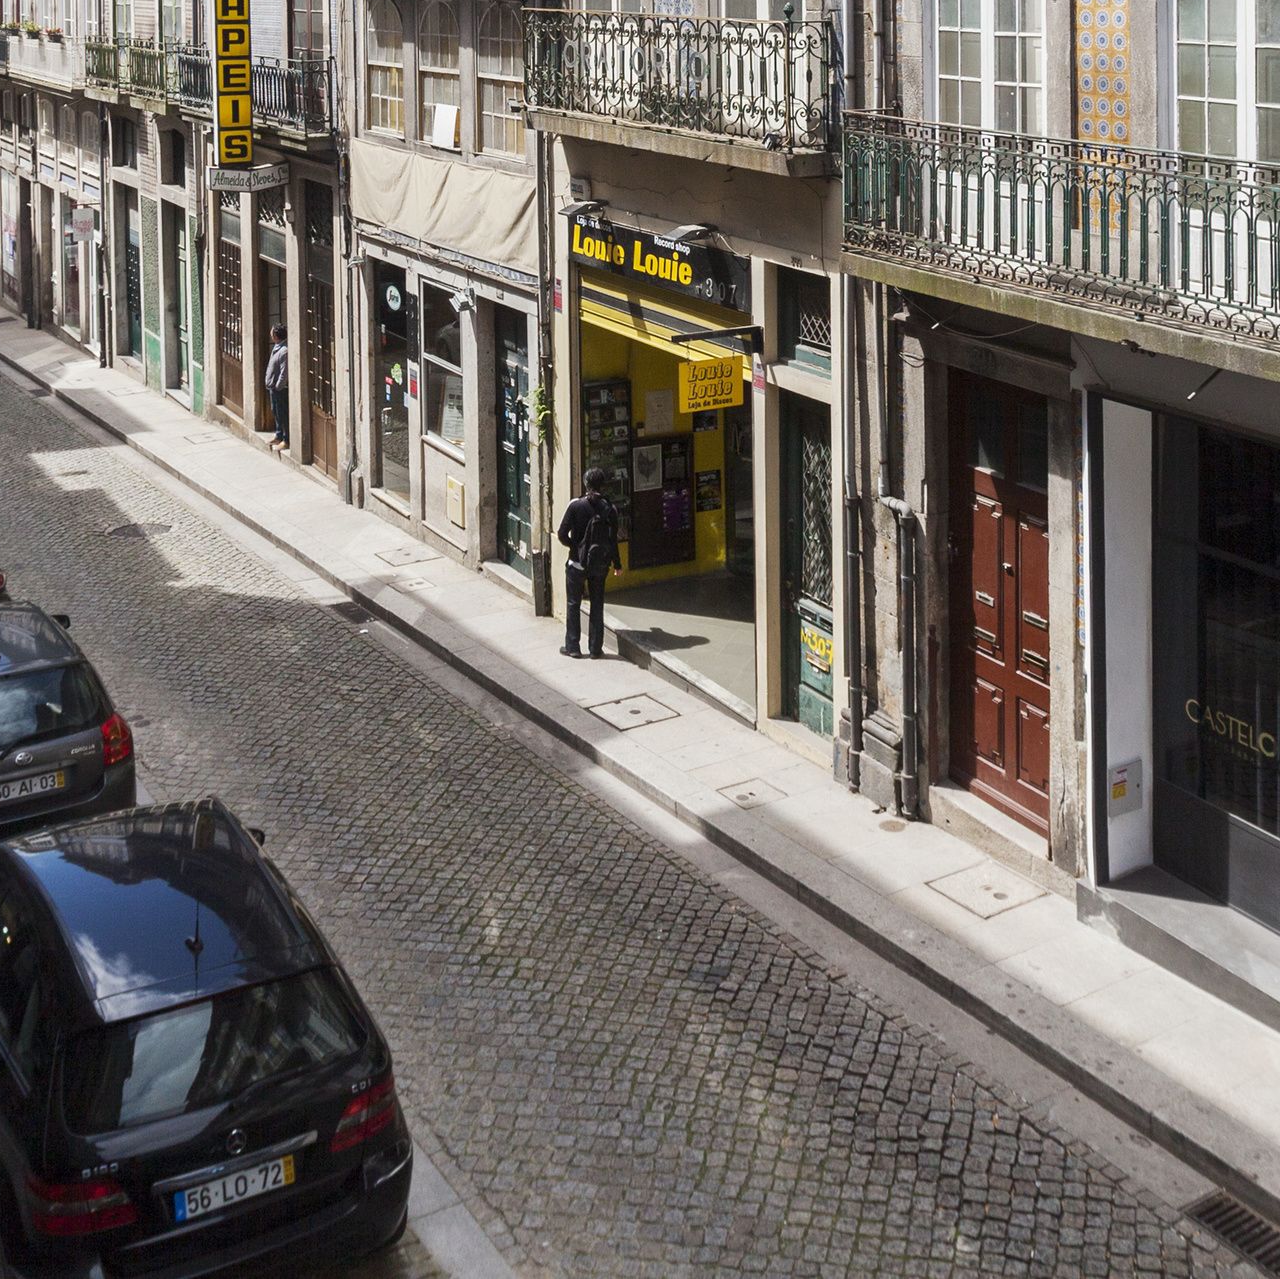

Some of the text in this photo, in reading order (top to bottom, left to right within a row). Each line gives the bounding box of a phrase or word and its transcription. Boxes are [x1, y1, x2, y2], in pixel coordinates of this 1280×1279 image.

[213, 171, 244, 187] Almeida
[573, 224, 693, 285] Louie Louie
[654, 235, 690, 256] Record shop
[688, 362, 733, 382] Louie
[688, 380, 733, 400] Louie
[688, 400, 701, 409] Loja
[713, 398, 733, 406] Discos
